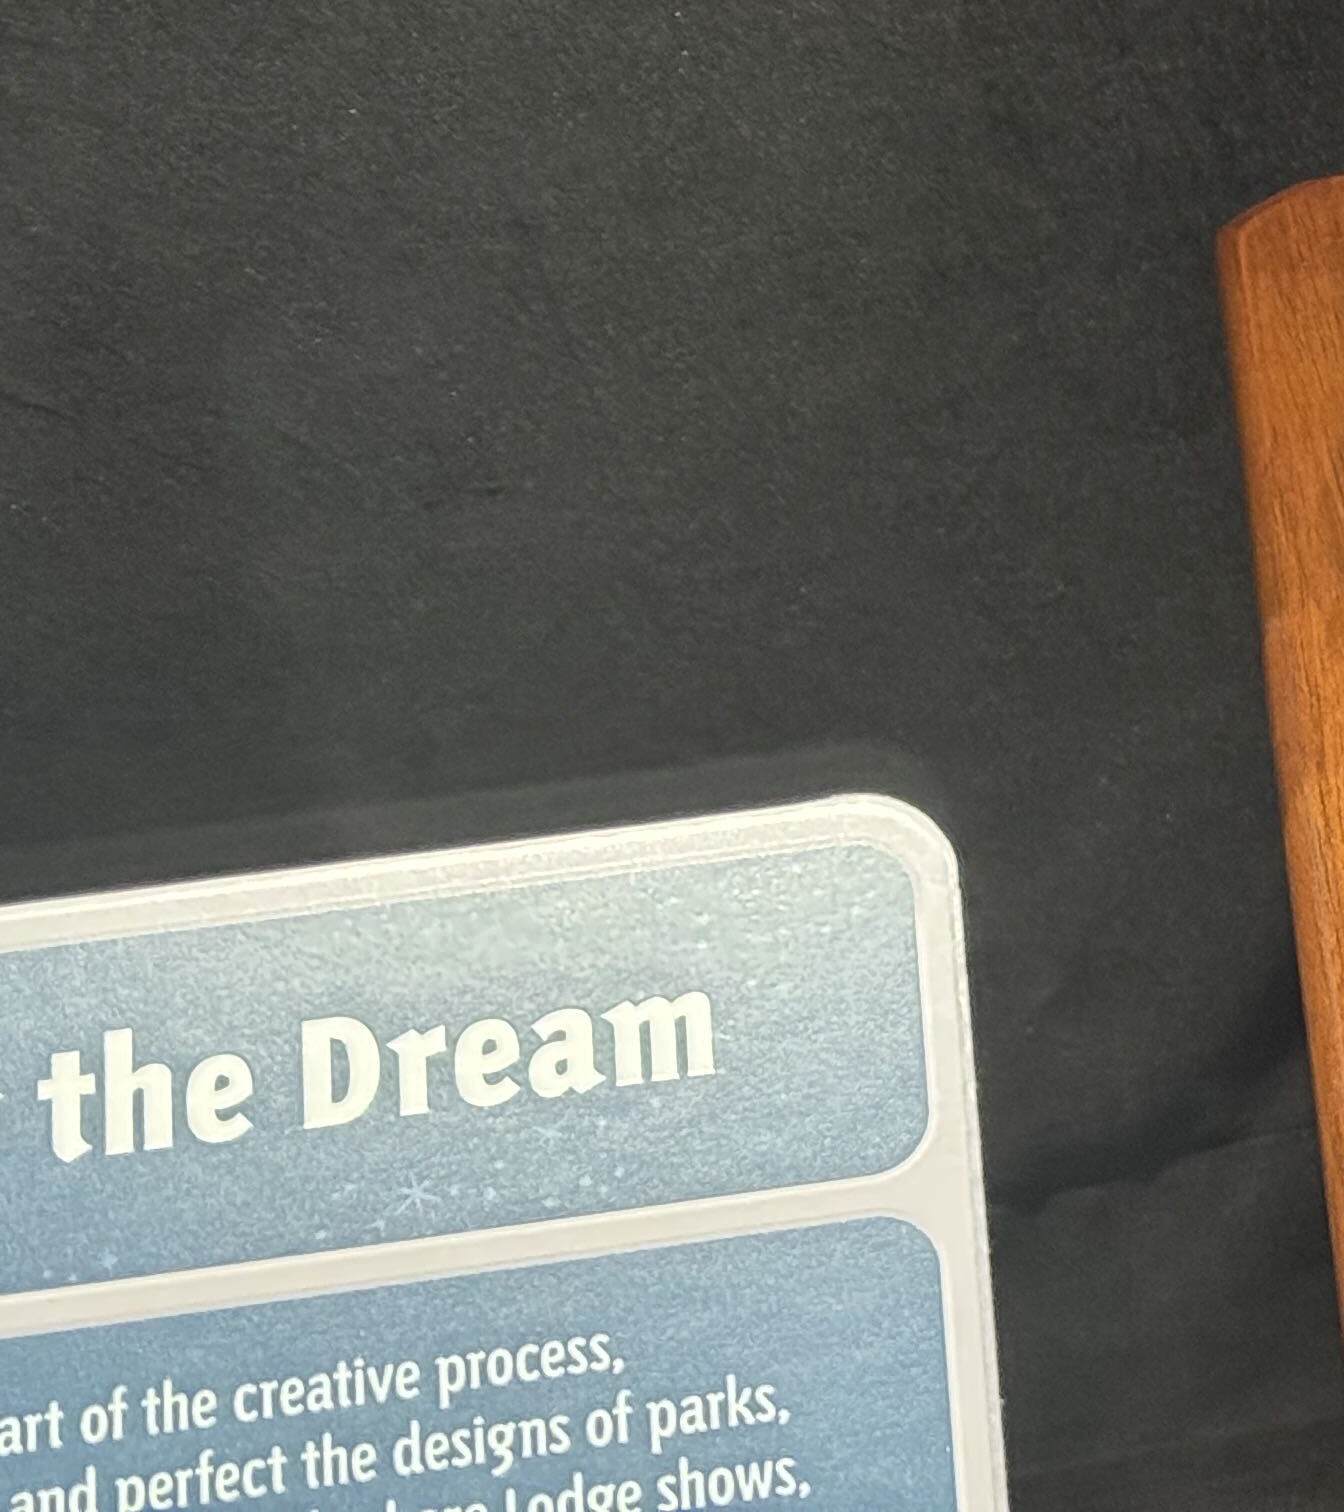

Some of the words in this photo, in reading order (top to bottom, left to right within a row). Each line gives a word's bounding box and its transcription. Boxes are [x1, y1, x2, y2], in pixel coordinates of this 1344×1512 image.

[37, 1024, 254, 1164] the
[301, 990, 718, 1130] Dream
[10, 1464, 98, 1512] and
[115, 1447, 288, 1512] perfect
[301, 1432, 377, 1489] the
[393, 1415, 571, 1478] designs
[586, 1389, 634, 1448] of
[646, 1373, 791, 1455] parks,
[80, 1384, 128, 1445] of
[141, 1377, 218, 1436] the
[233, 1356, 421, 1423] creative
[435, 1332, 625, 1410] process,
[656, 1455, 811, 1512] shows,
